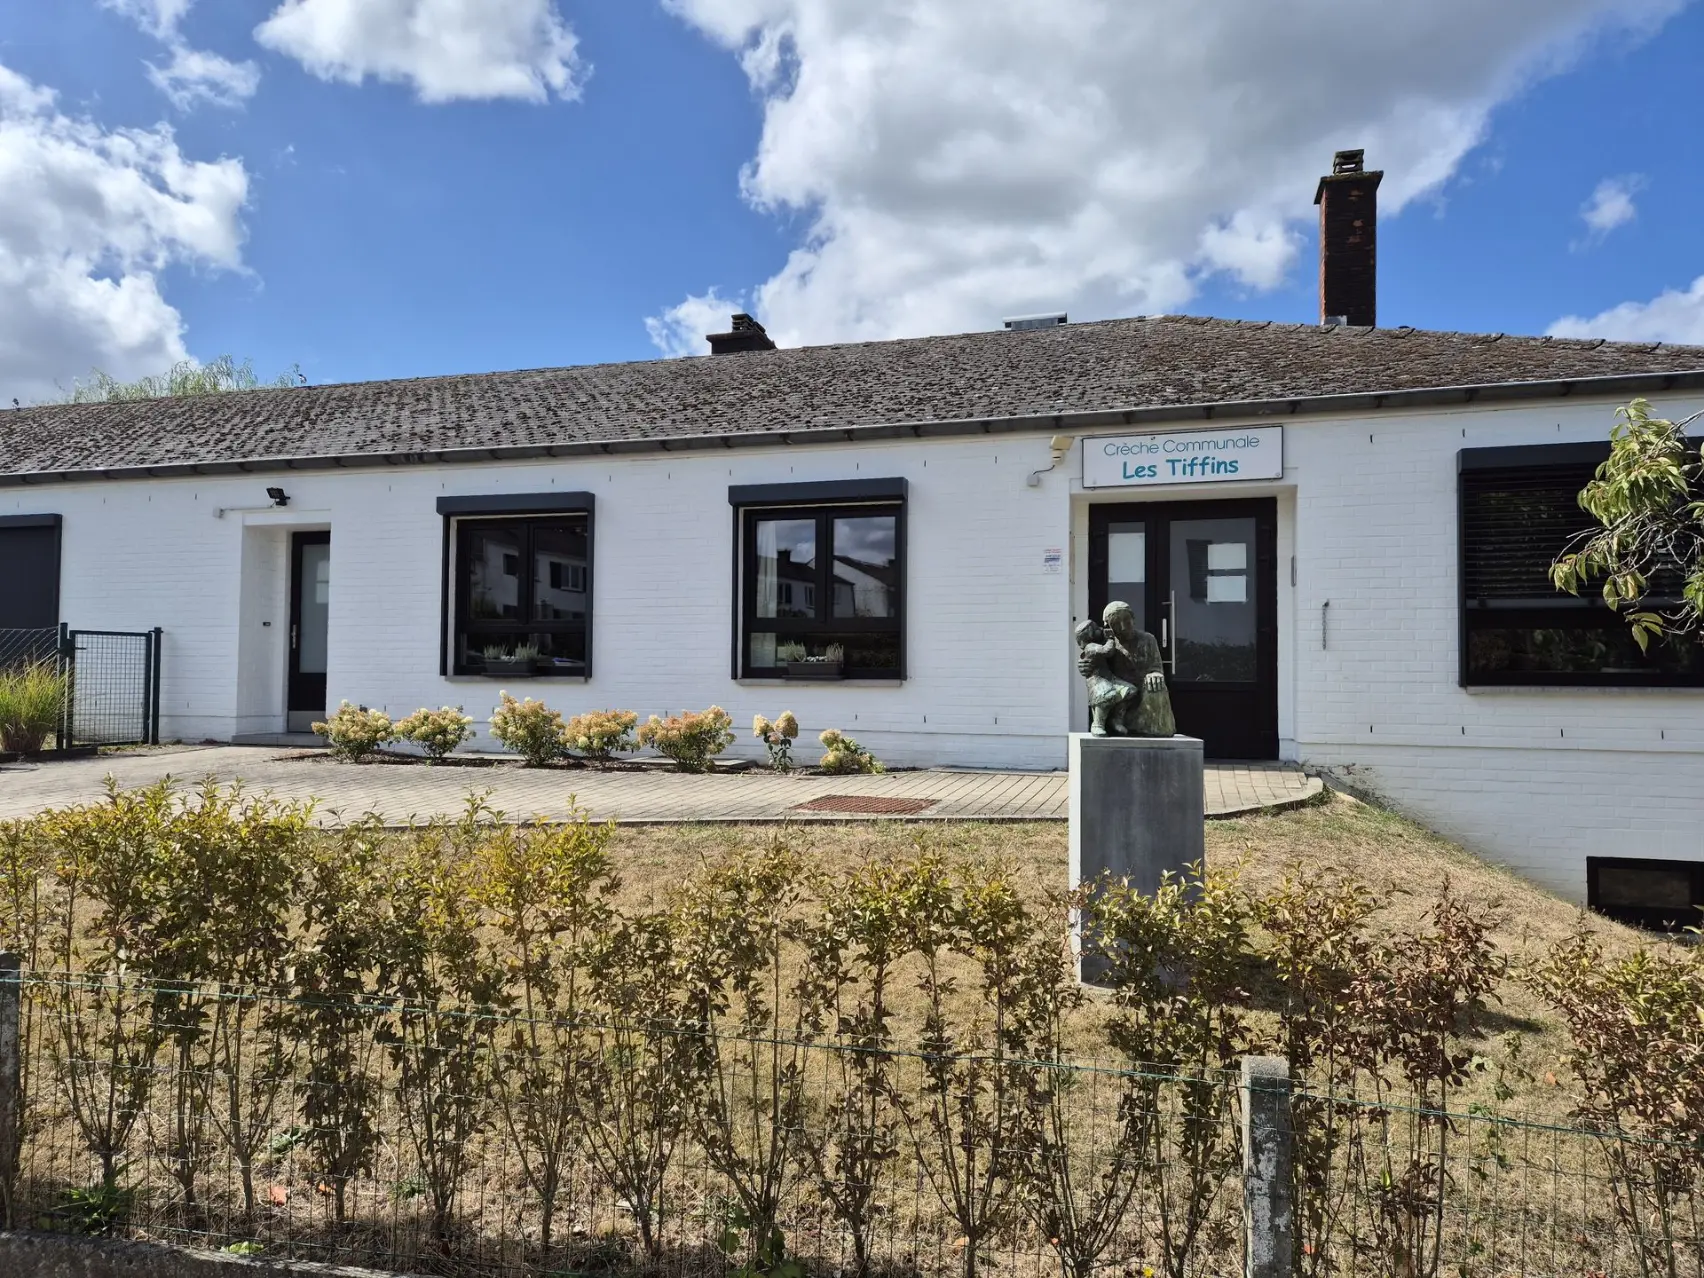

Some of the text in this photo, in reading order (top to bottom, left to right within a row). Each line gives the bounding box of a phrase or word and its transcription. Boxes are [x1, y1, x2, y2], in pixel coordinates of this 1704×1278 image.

[1103, 435, 1260, 456] Crèche Communale
[1122, 456, 1239, 480] Les Tiffins
